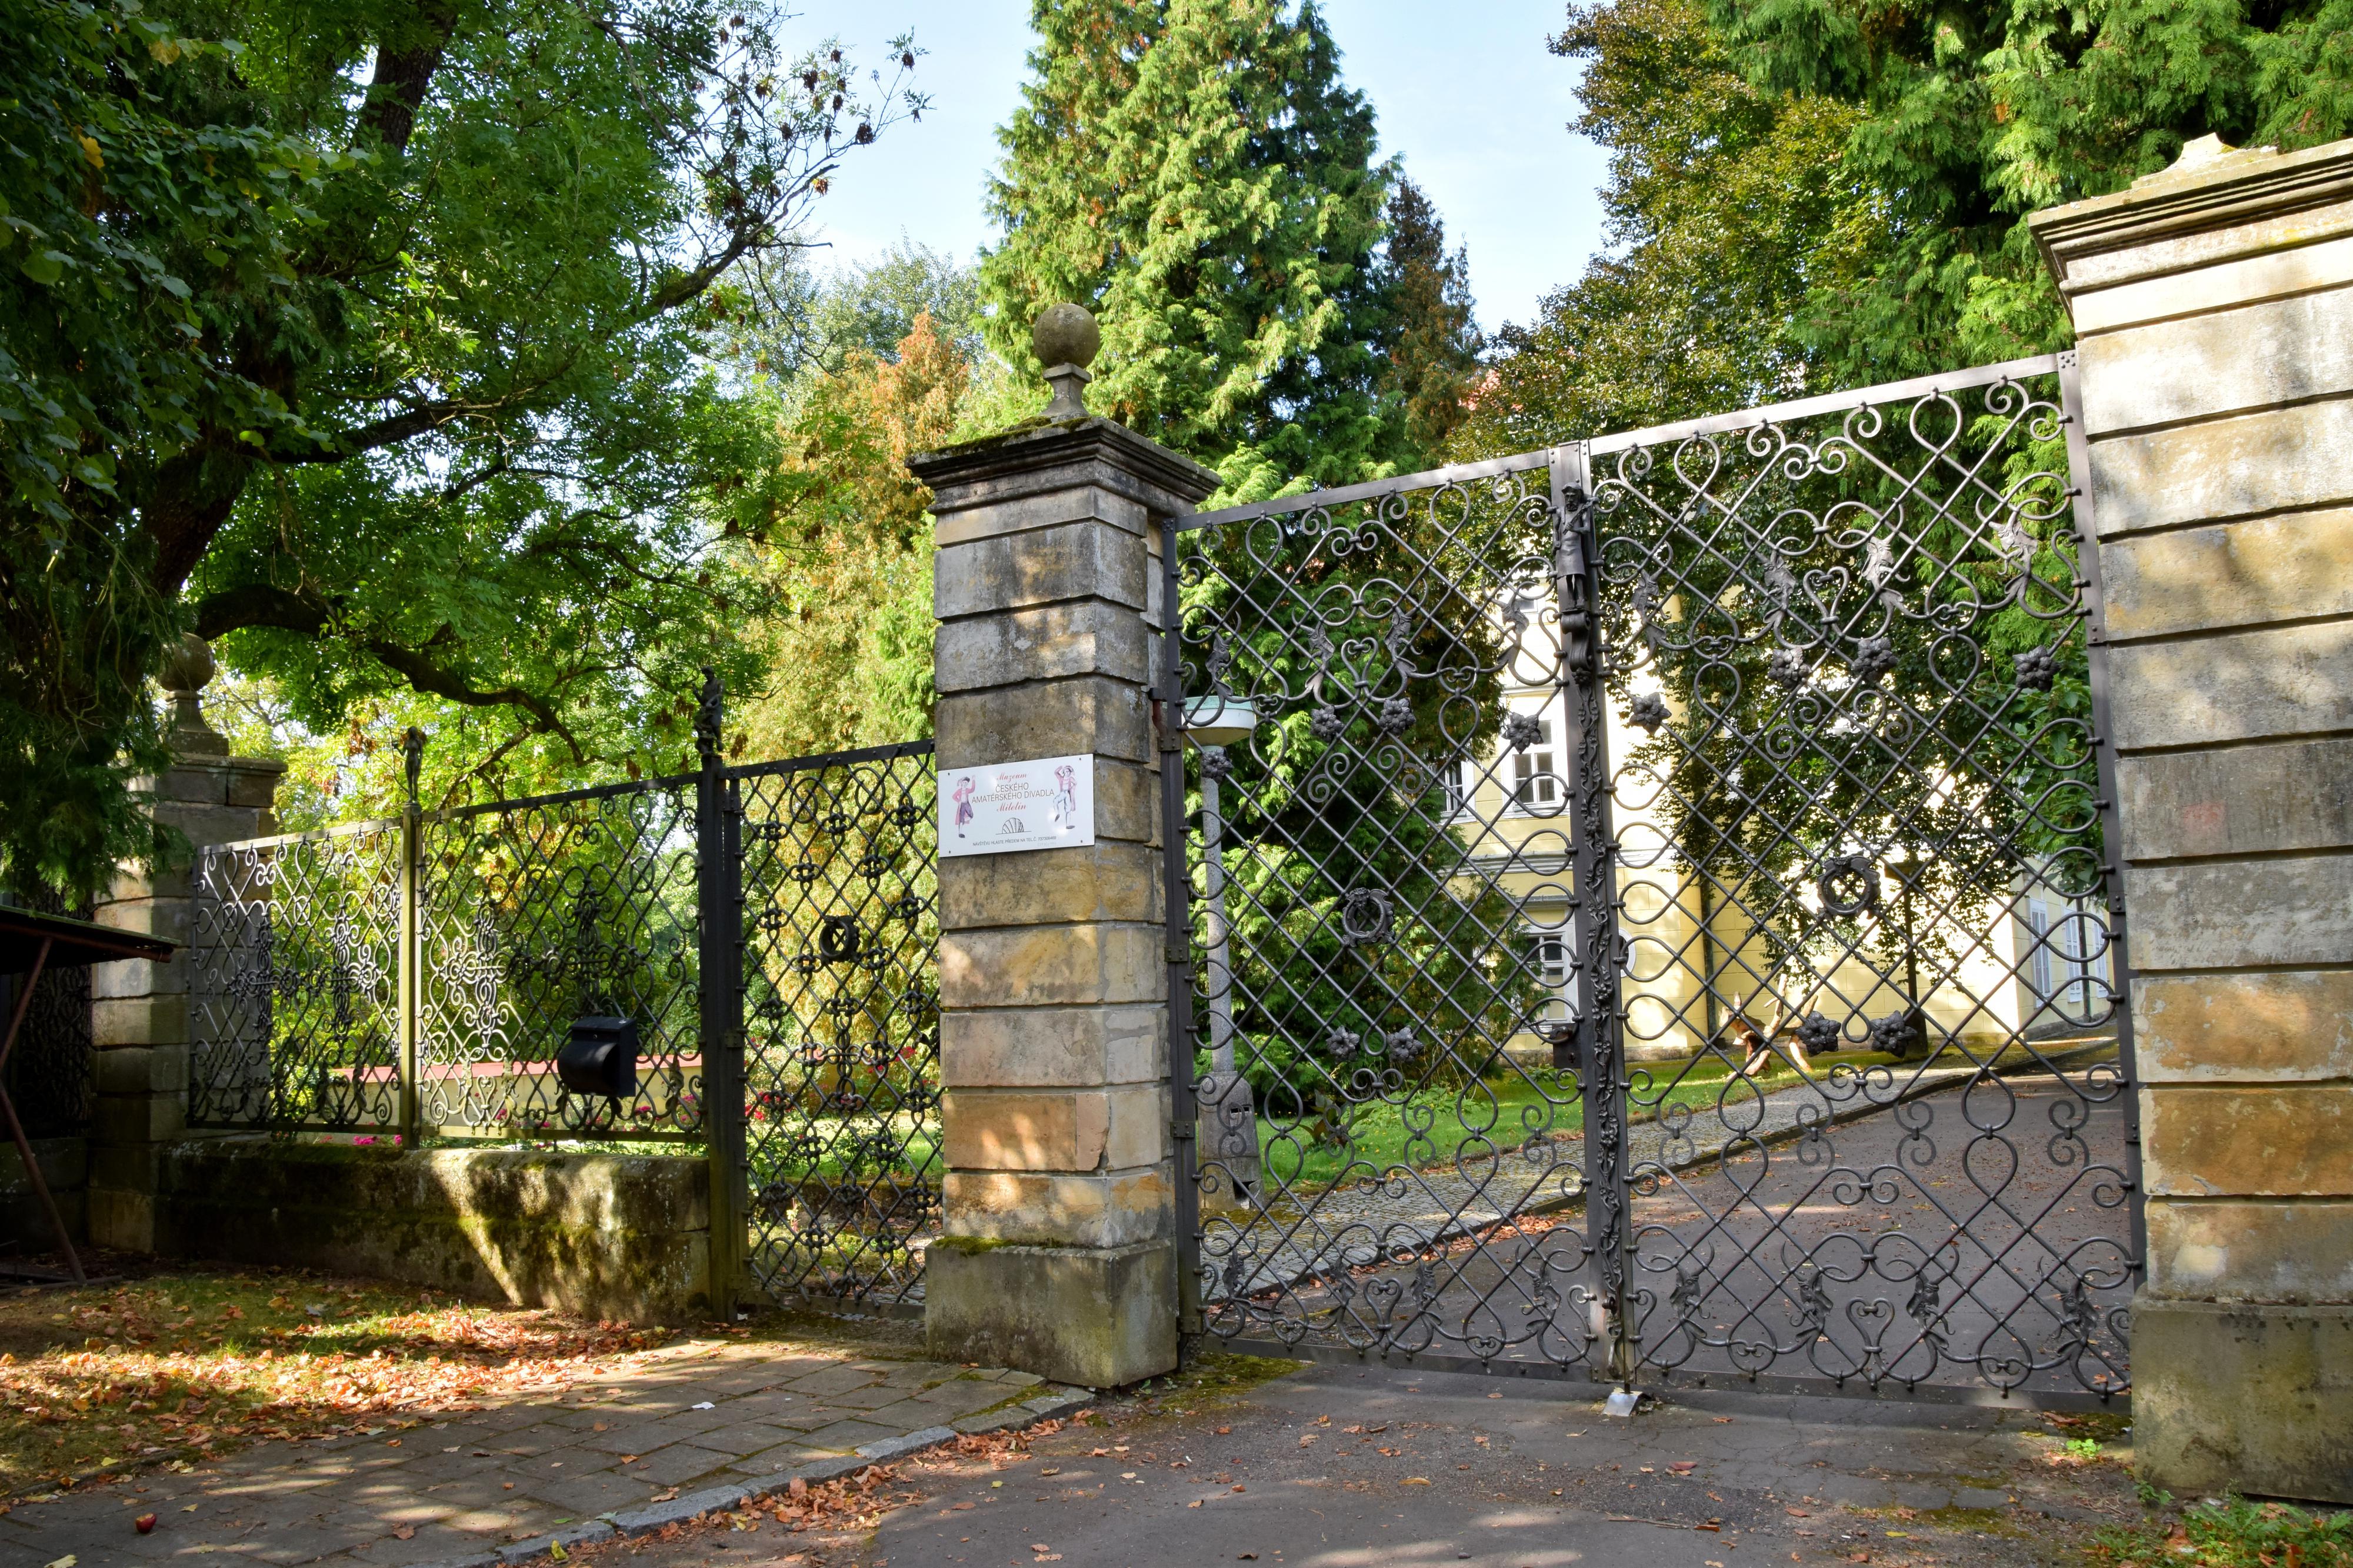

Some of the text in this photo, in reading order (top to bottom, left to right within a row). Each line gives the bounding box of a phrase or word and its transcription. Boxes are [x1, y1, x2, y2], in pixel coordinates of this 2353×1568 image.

[996, 772, 1026, 783] Muzeum
[995, 782, 1029, 793] ČESKÉHO
[972, 789, 1054, 803] AMATÉRSKÉHO DIVADLA
